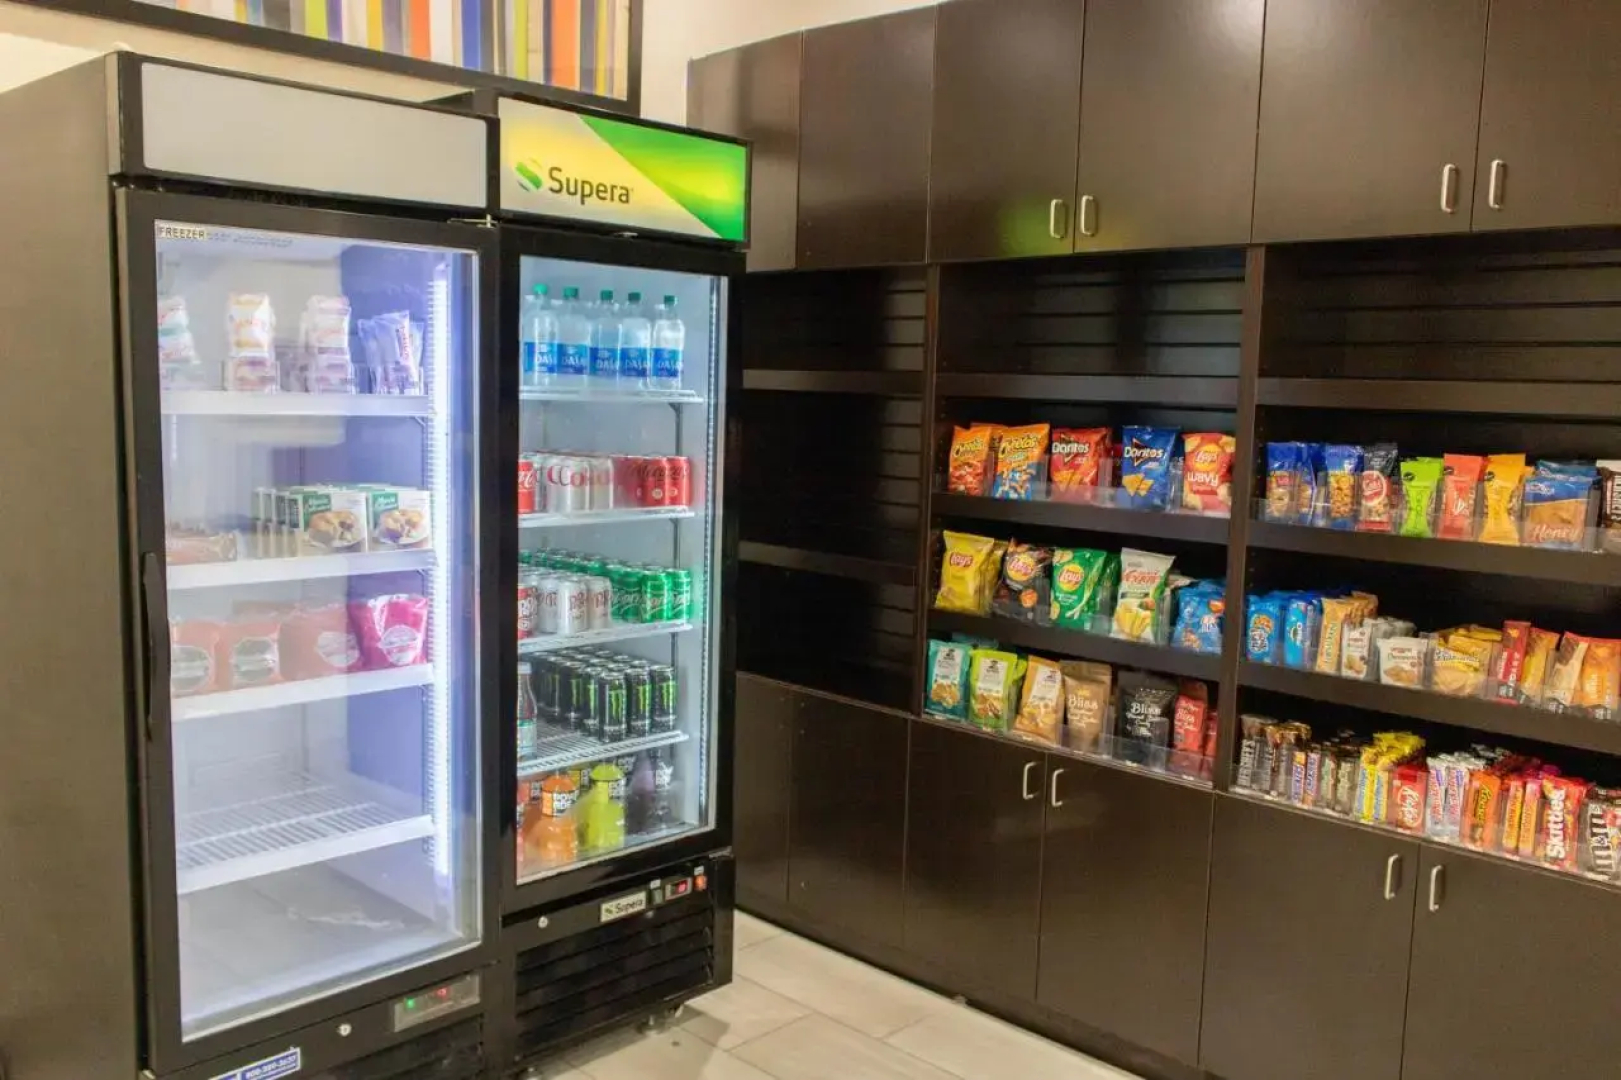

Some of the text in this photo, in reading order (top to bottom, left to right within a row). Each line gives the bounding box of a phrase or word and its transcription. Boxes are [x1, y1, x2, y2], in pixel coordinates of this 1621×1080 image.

[548, 166, 630, 206] Supera
[157, 226, 205, 239] FREEZER
[999, 436, 1038, 459] Cheetos
[1052, 441, 1089, 454] Doritos
[1124, 446, 1163, 459] Doritos
[1532, 524, 1582, 543] Honey
[1130, 702, 1162, 715] Bliss
[1546, 788, 1566, 859] Skittles
